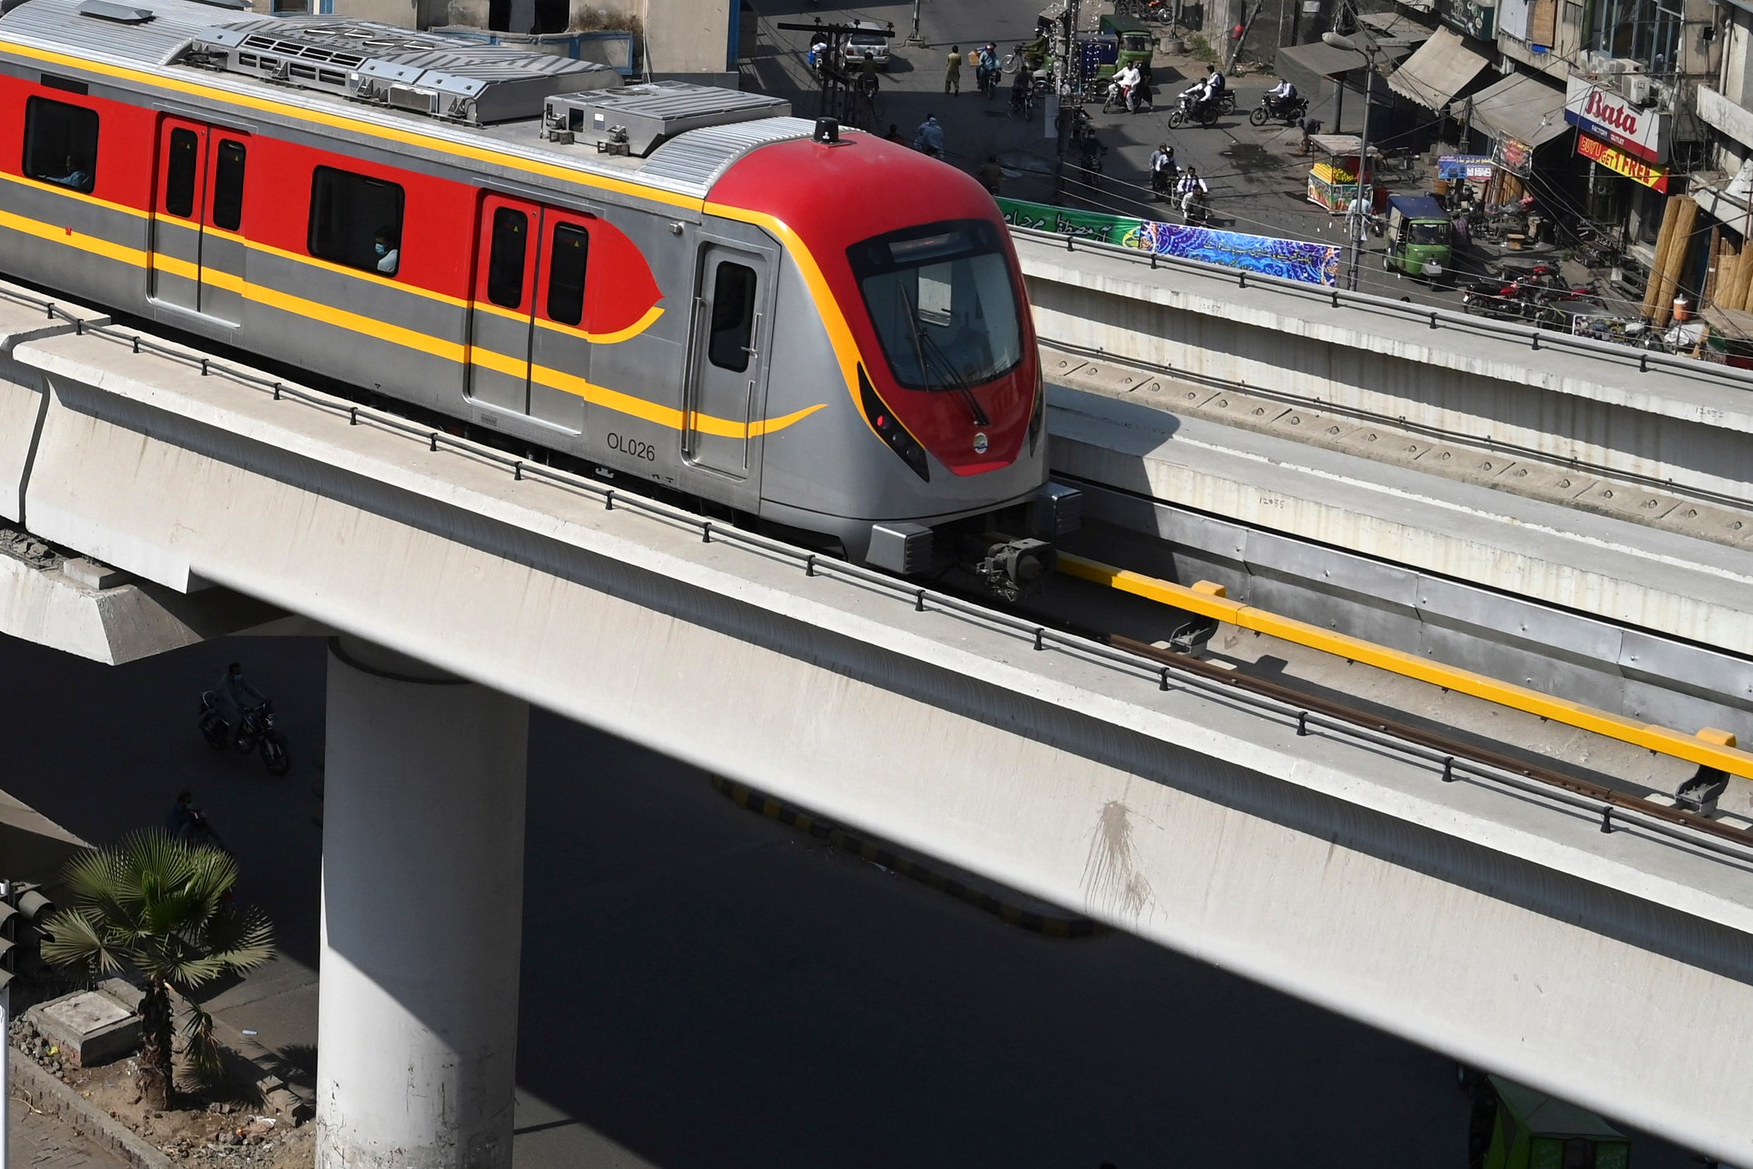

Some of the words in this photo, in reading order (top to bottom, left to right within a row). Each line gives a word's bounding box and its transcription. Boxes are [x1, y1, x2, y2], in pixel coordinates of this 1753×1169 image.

[1585, 90, 1638, 136] Bata
[1601, 150, 1615, 166] GET
[1622, 157, 1652, 185] FREE
[607, 432, 656, 462] OL026
